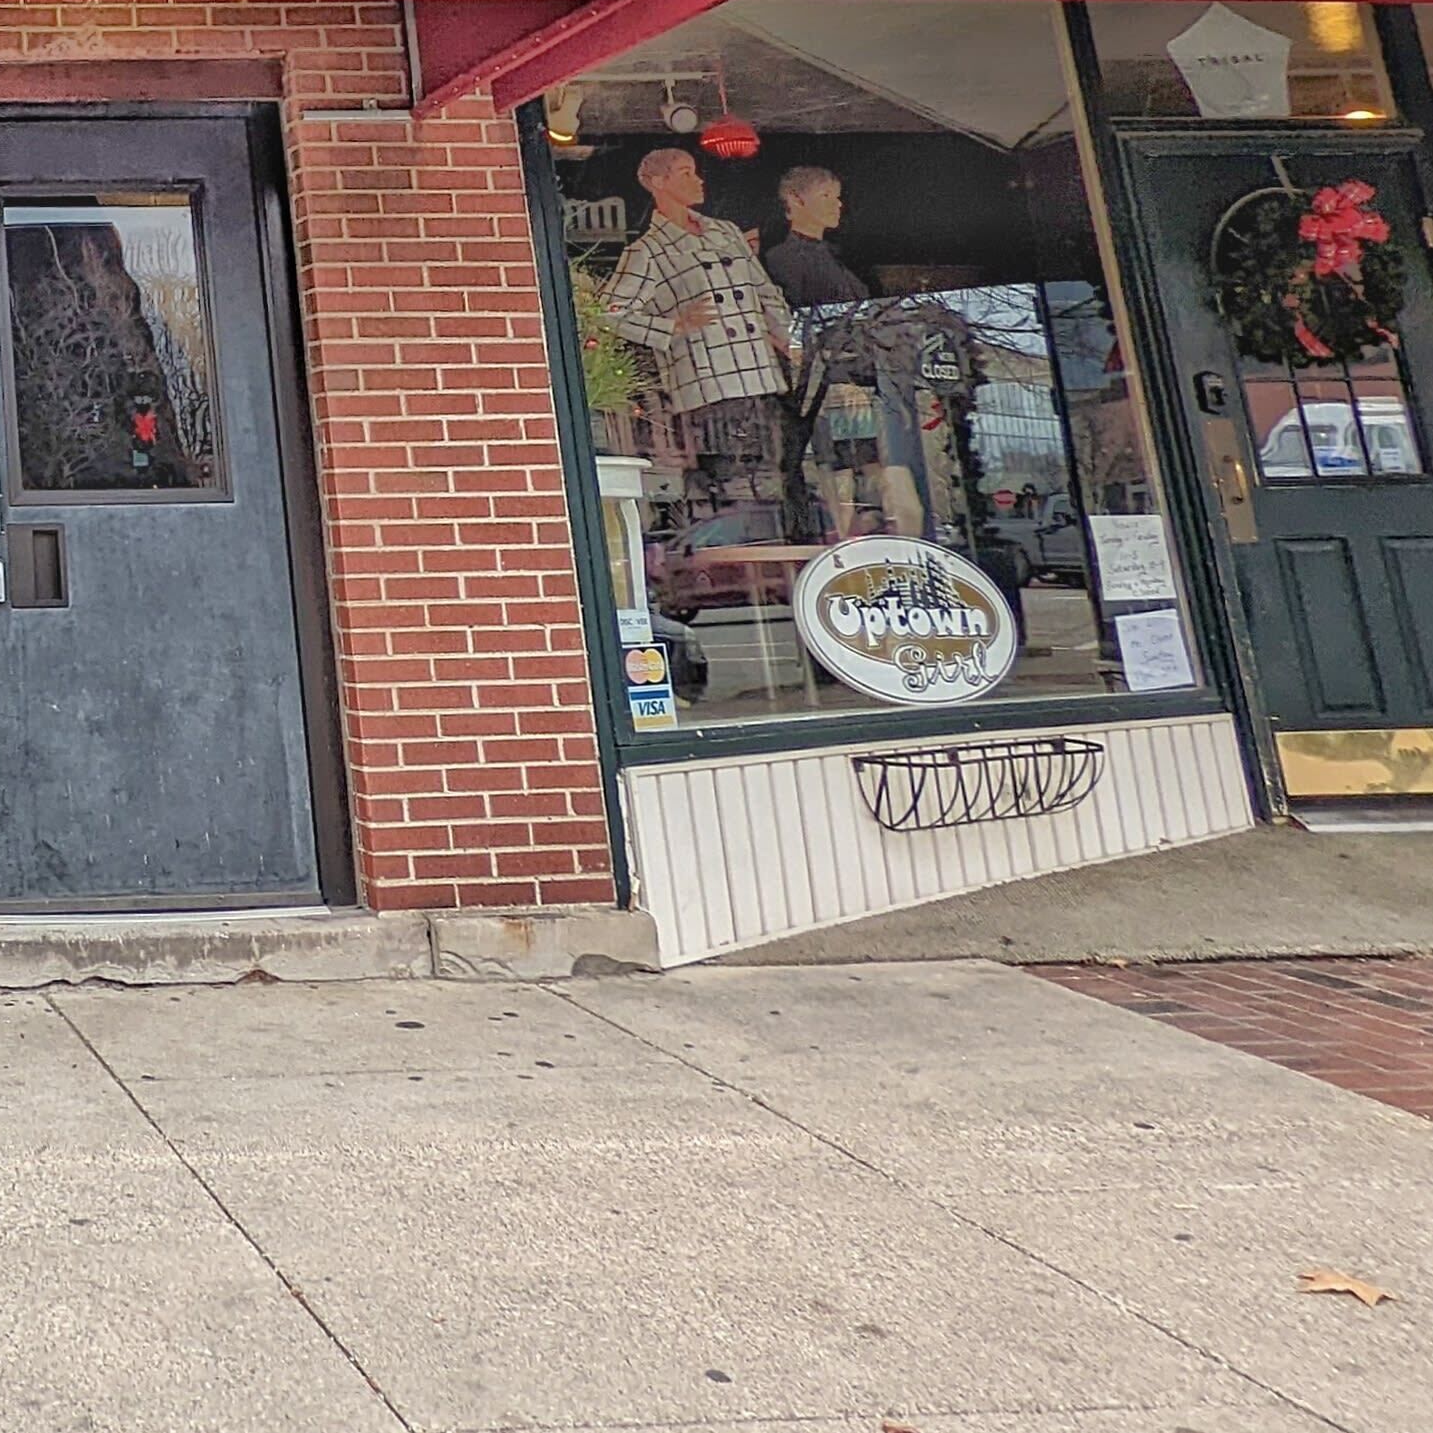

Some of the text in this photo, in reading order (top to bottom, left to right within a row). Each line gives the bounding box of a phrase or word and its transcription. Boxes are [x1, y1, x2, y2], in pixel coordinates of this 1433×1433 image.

[826, 595, 992, 648] Uptown
[893, 638, 999, 693] Girl
[638, 700, 666, 716] VISA
